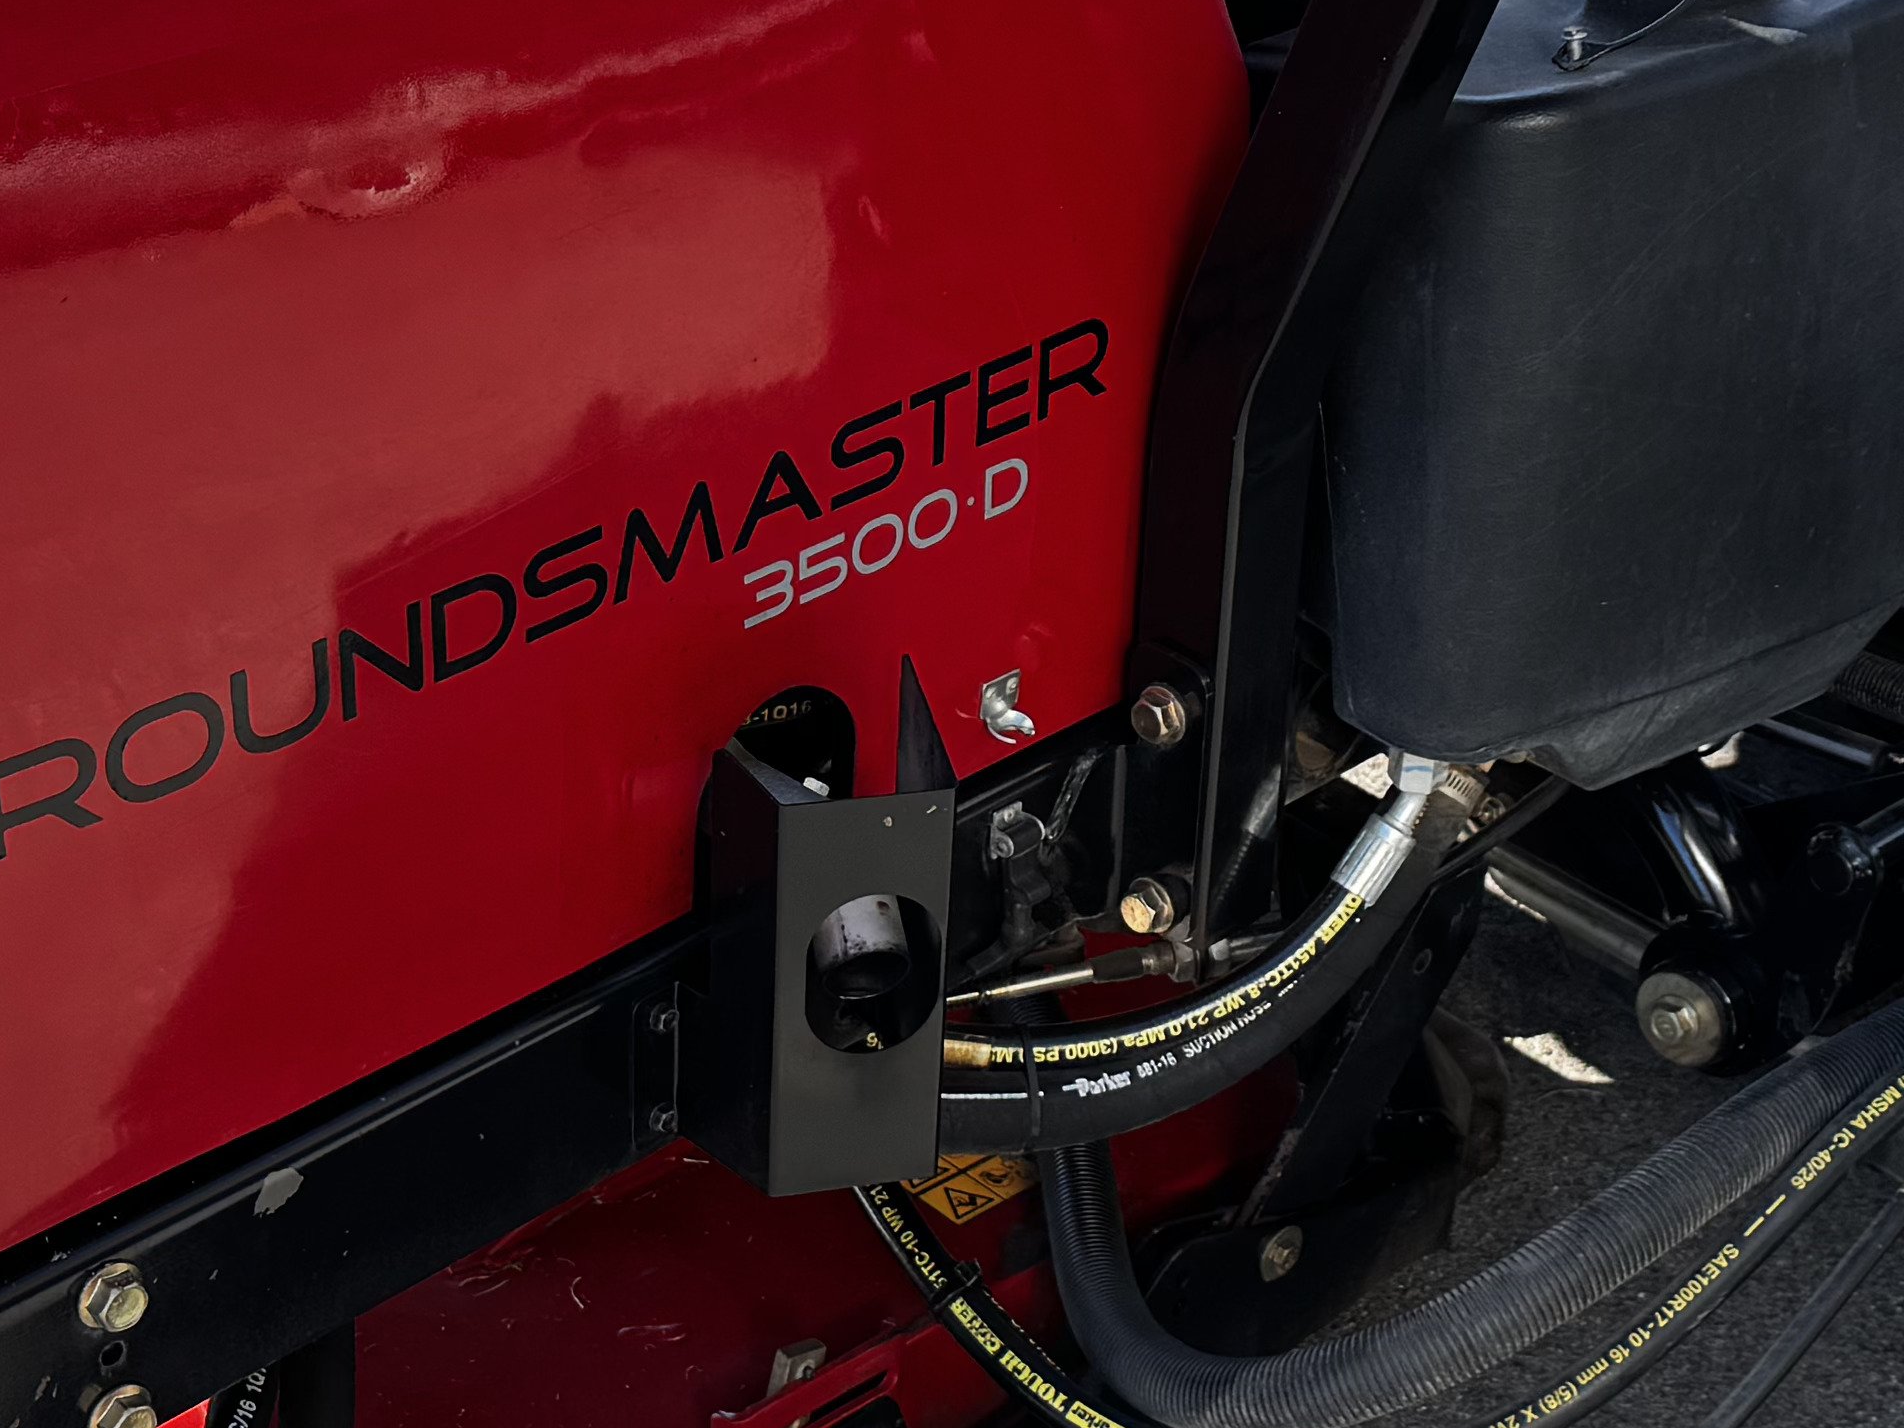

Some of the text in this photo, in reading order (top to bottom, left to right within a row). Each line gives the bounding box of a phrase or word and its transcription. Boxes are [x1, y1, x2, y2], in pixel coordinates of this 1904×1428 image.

[1213, 993, 1246, 1019] WP
[1124, 1026, 1167, 1047] MPa
[1849, 1085, 1903, 1130] MSHA
[1790, 1127, 1856, 1191] IC-40/26
[881, 1207, 904, 1232] WP
[1609, 1344, 1630, 1364] 16
[998, 1349, 1069, 1413] TOUGH
[1576, 1357, 1610, 1385] mm
[1538, 1381, 1578, 1414] (5/8)
